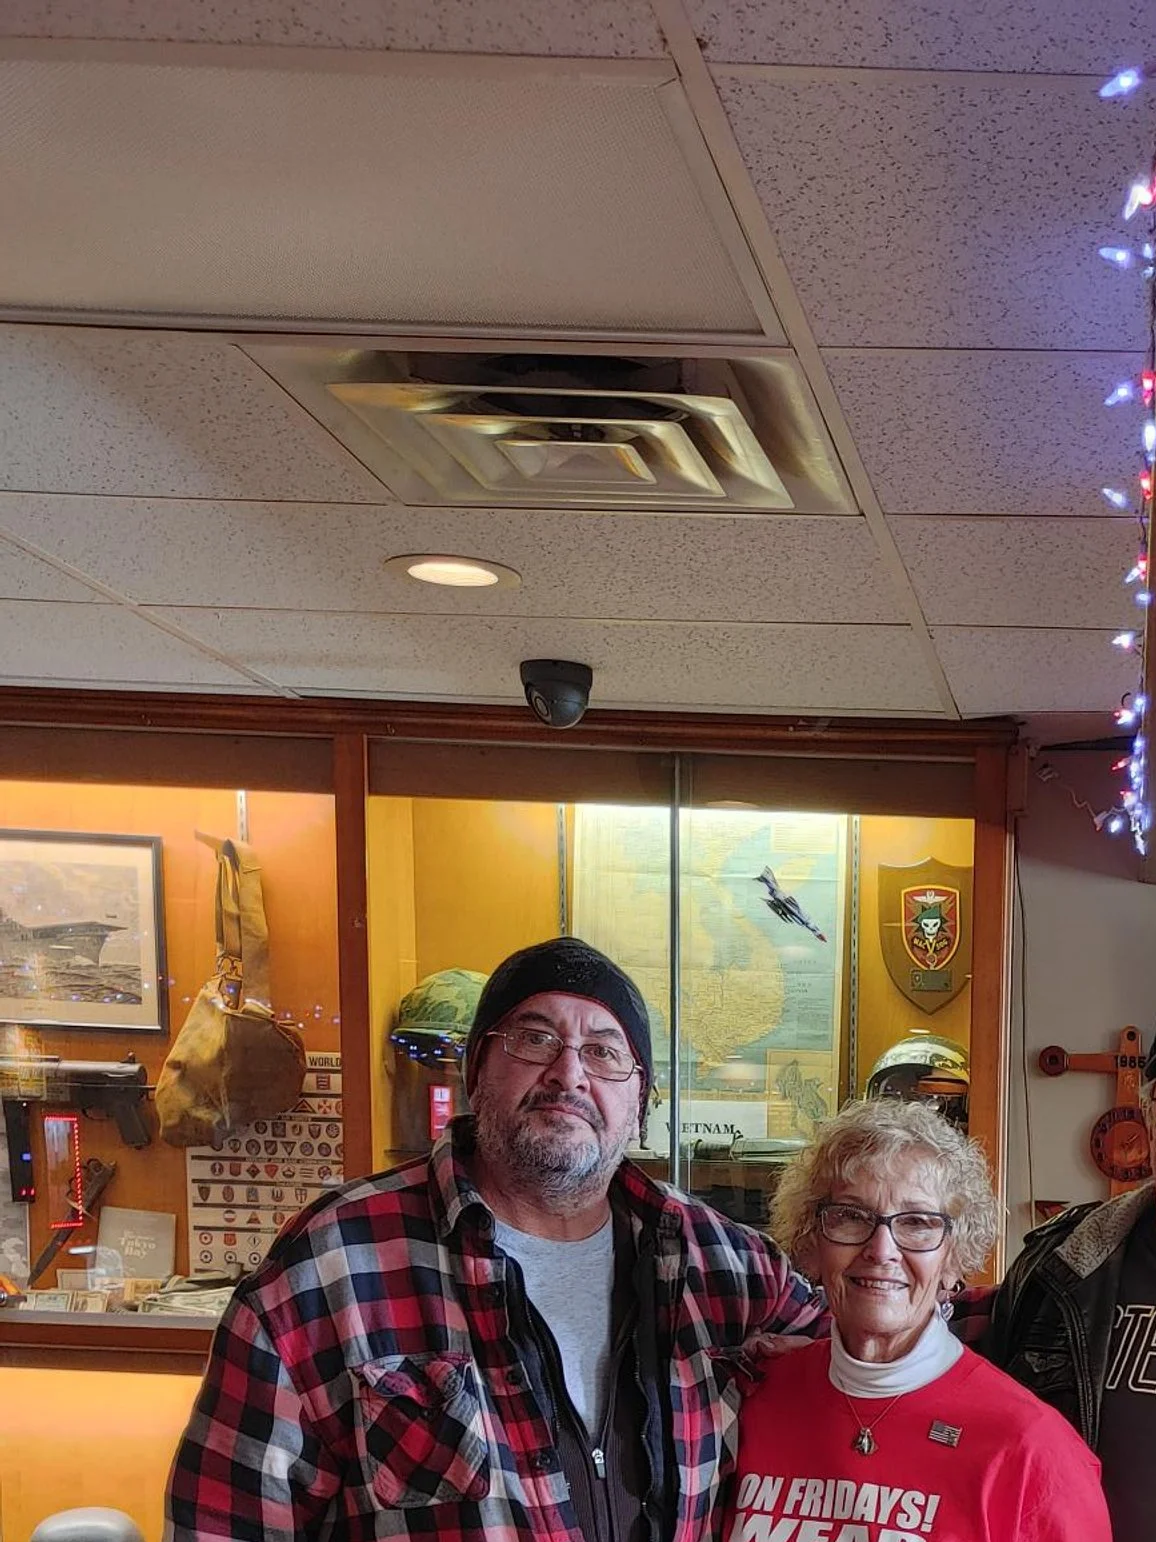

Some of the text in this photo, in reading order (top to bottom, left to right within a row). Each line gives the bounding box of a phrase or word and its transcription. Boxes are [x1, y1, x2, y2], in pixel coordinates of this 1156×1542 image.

[308, 1055, 342, 1068] WORLD
[666, 1122, 736, 1135] VETNAM
[737, 1473, 941, 1534] ON FRIDAYS!
